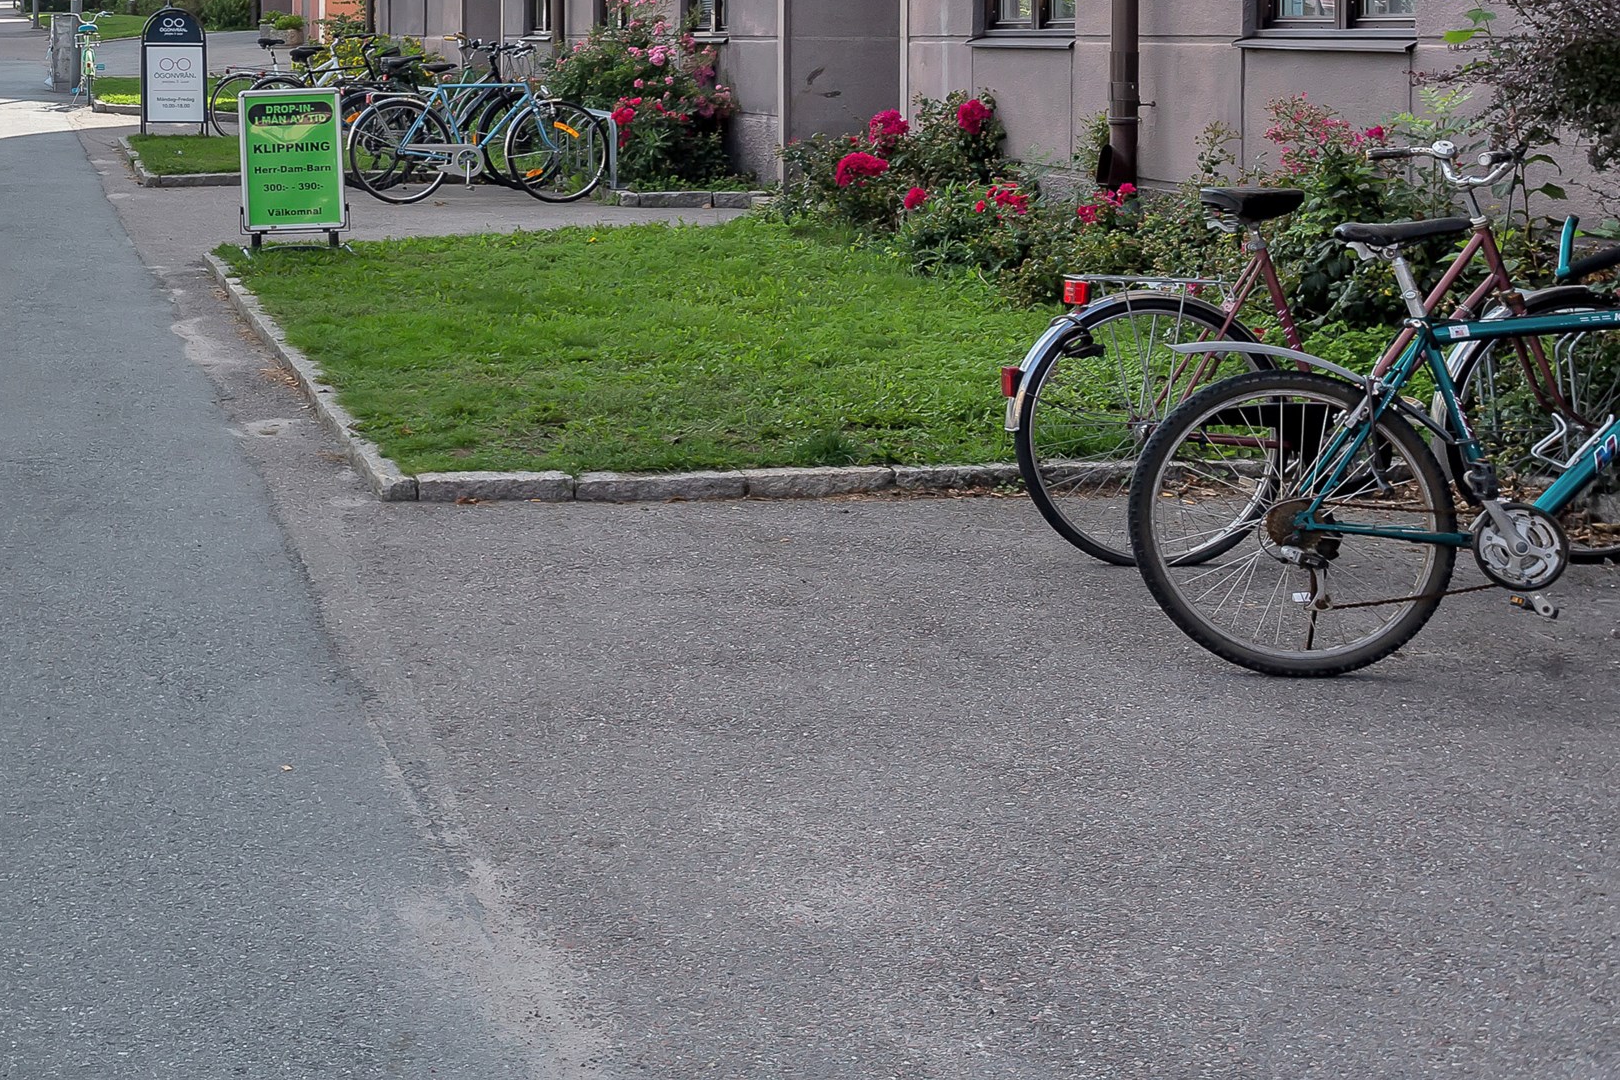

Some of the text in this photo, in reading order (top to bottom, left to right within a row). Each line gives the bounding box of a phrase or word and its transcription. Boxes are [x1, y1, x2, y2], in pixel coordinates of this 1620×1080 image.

[261, 114, 287, 125] MÅN
[290, 115, 305, 123] AV
[308, 113, 327, 122] TID
[253, 142, 330, 154] KLIPPNING
[254, 164, 332, 174] Herr-Dam-Barn
[263, 183, 289, 192] 300:-
[298, 182, 324, 191] 390:-
